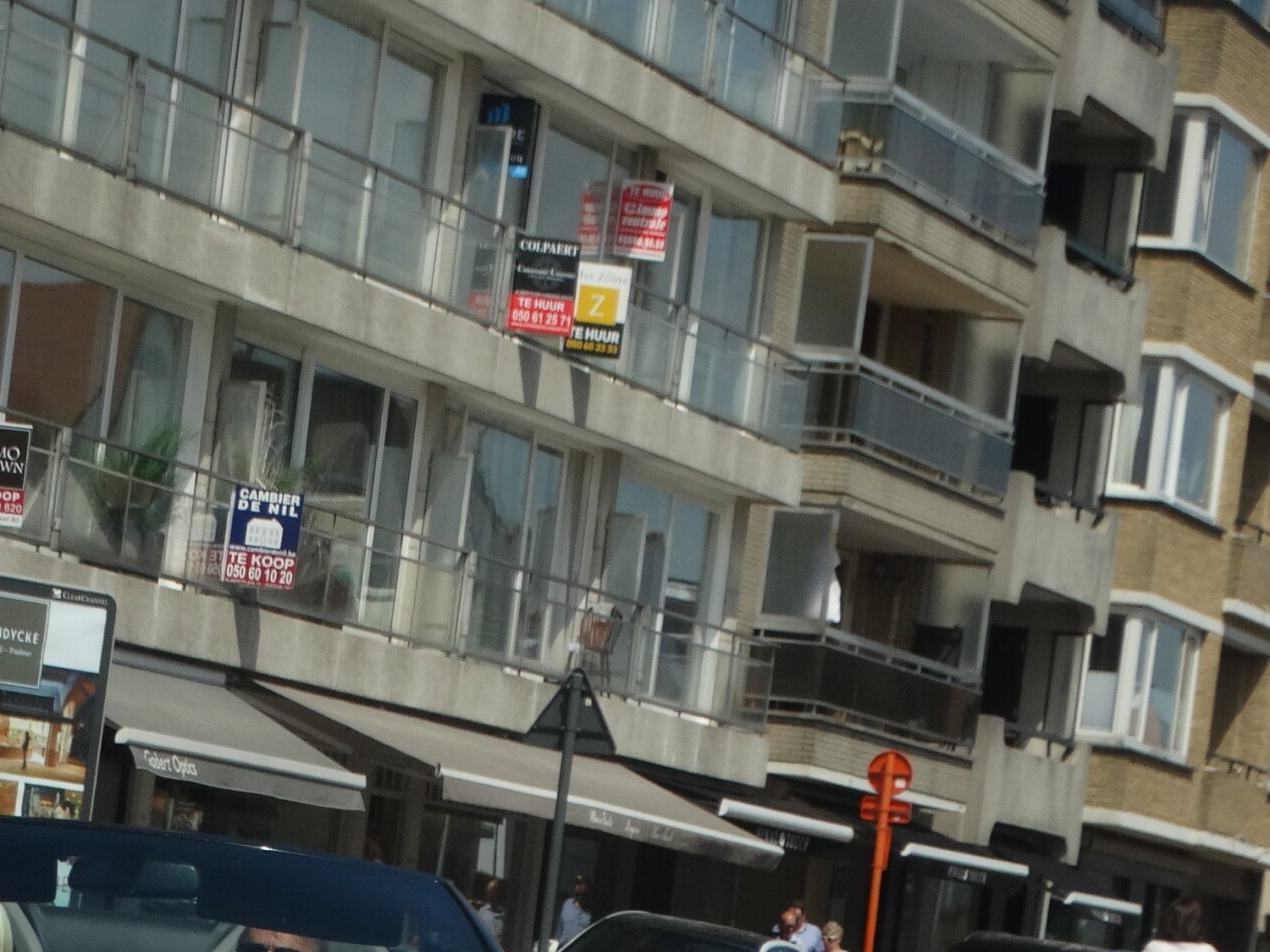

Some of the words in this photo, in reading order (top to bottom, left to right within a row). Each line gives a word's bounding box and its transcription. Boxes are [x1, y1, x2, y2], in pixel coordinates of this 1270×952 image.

[629, 186, 640, 197] TE
[519, 239, 579, 258] COLPAERT
[518, 298, 531, 307] TE
[535, 300, 565, 313] HUUR
[588, 294, 607, 317] Z
[512, 309, 529, 322] 050
[531, 312, 543, 324] 61
[560, 316, 571, 327] 71
[585, 329, 620, 344] HUUR
[239, 488, 301, 507] CAMBIER
[4, 503, 22, 513] 820
[238, 500, 261, 513] DE
[268, 504, 298, 518] NIL
[229, 552, 247, 565] TE
[251, 555, 295, 570] KOOP
[226, 564, 246, 578] 050
[248, 568, 262, 581] 60
[264, 569, 277, 583] 10
[279, 571, 293, 585] 20
